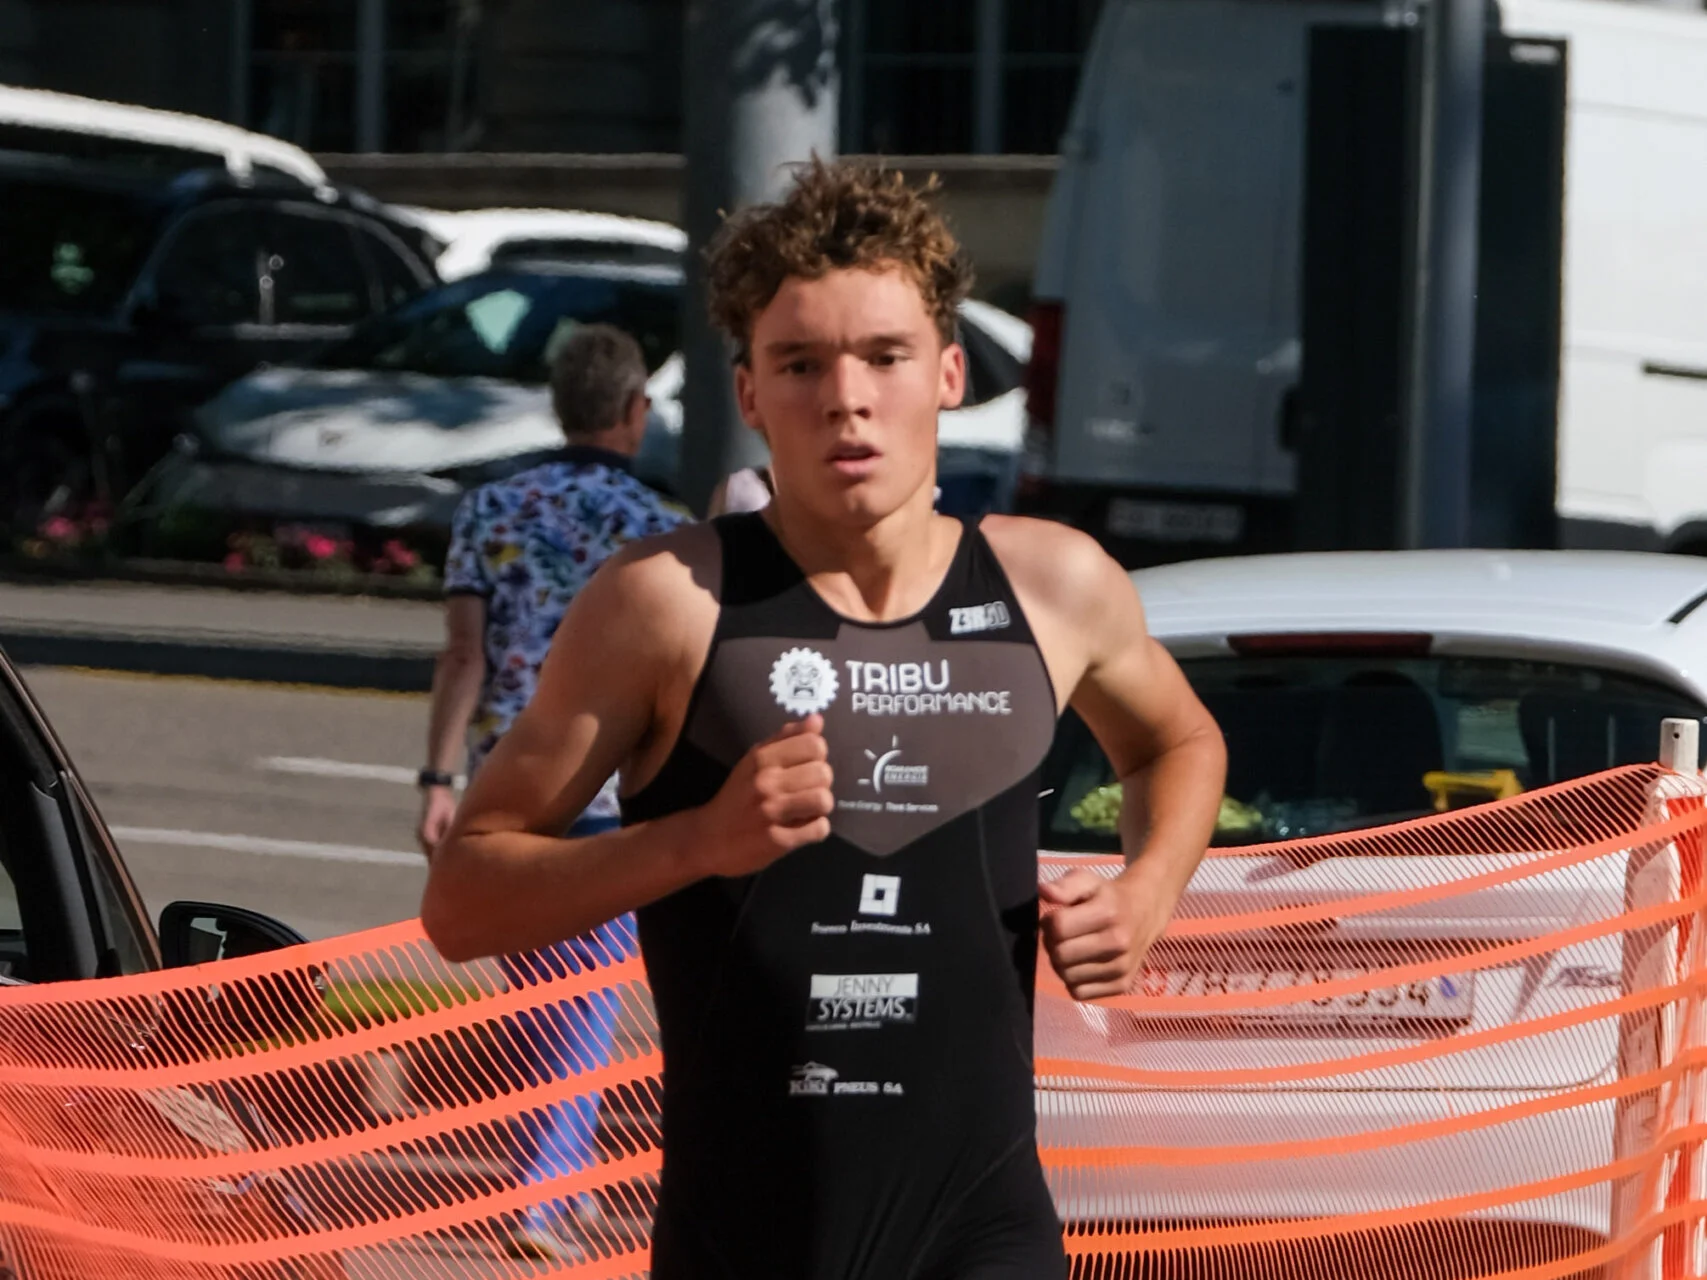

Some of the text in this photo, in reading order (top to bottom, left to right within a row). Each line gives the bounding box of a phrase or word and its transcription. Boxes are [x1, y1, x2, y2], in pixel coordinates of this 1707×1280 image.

[845, 659, 950, 693] TRIBU
[852, 691, 1012, 715] PERFORMANCE
[833, 976, 895, 997] JENNY
